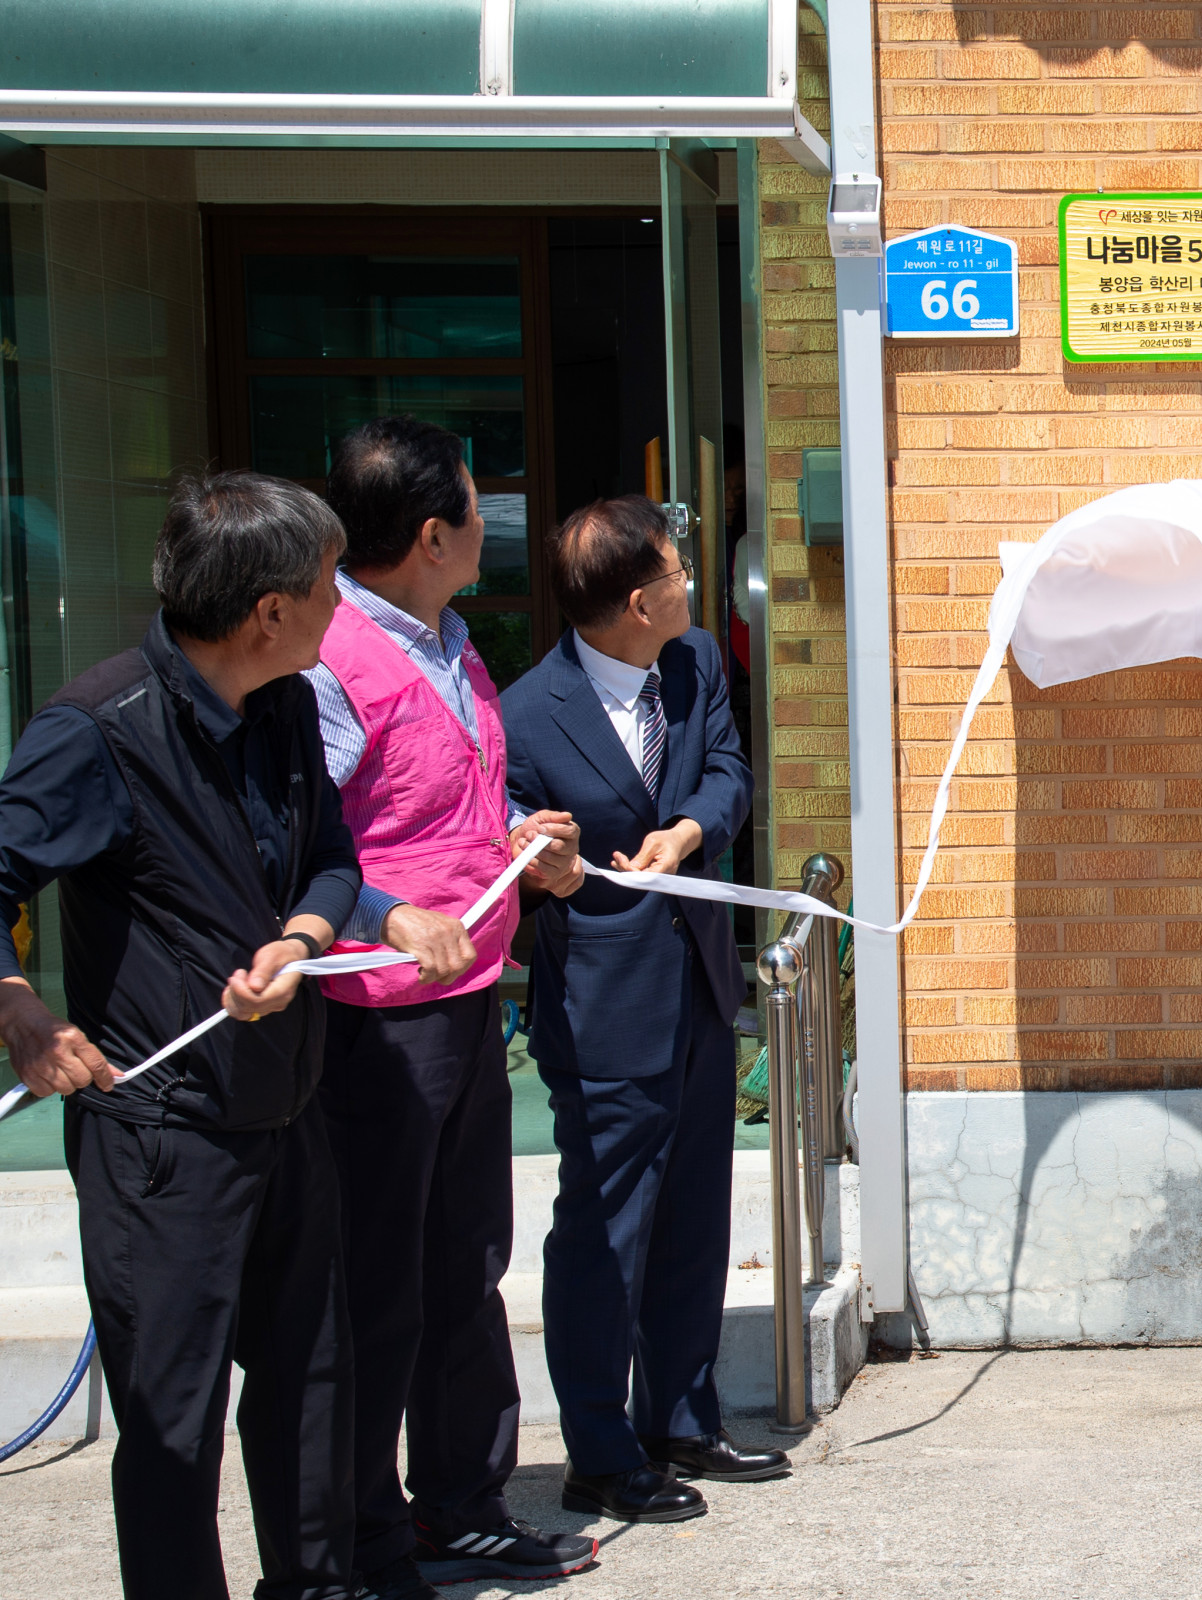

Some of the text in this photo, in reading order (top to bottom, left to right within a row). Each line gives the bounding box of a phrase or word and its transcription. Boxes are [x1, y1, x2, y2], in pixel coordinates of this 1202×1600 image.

[1120, 210, 1153, 223] 세상을
[1087, 235, 1183, 264] 나눔마을
[903, 260, 937, 269] Jewon
[963, 259, 974, 268] 11
[986, 258, 999, 270] gil
[1099, 276, 1143, 293] 봉양읍
[1149, 276, 1193, 291] 학산리
[921, 279, 980, 320] 66
[1140, 338, 1192, 348] 2024년 05월
